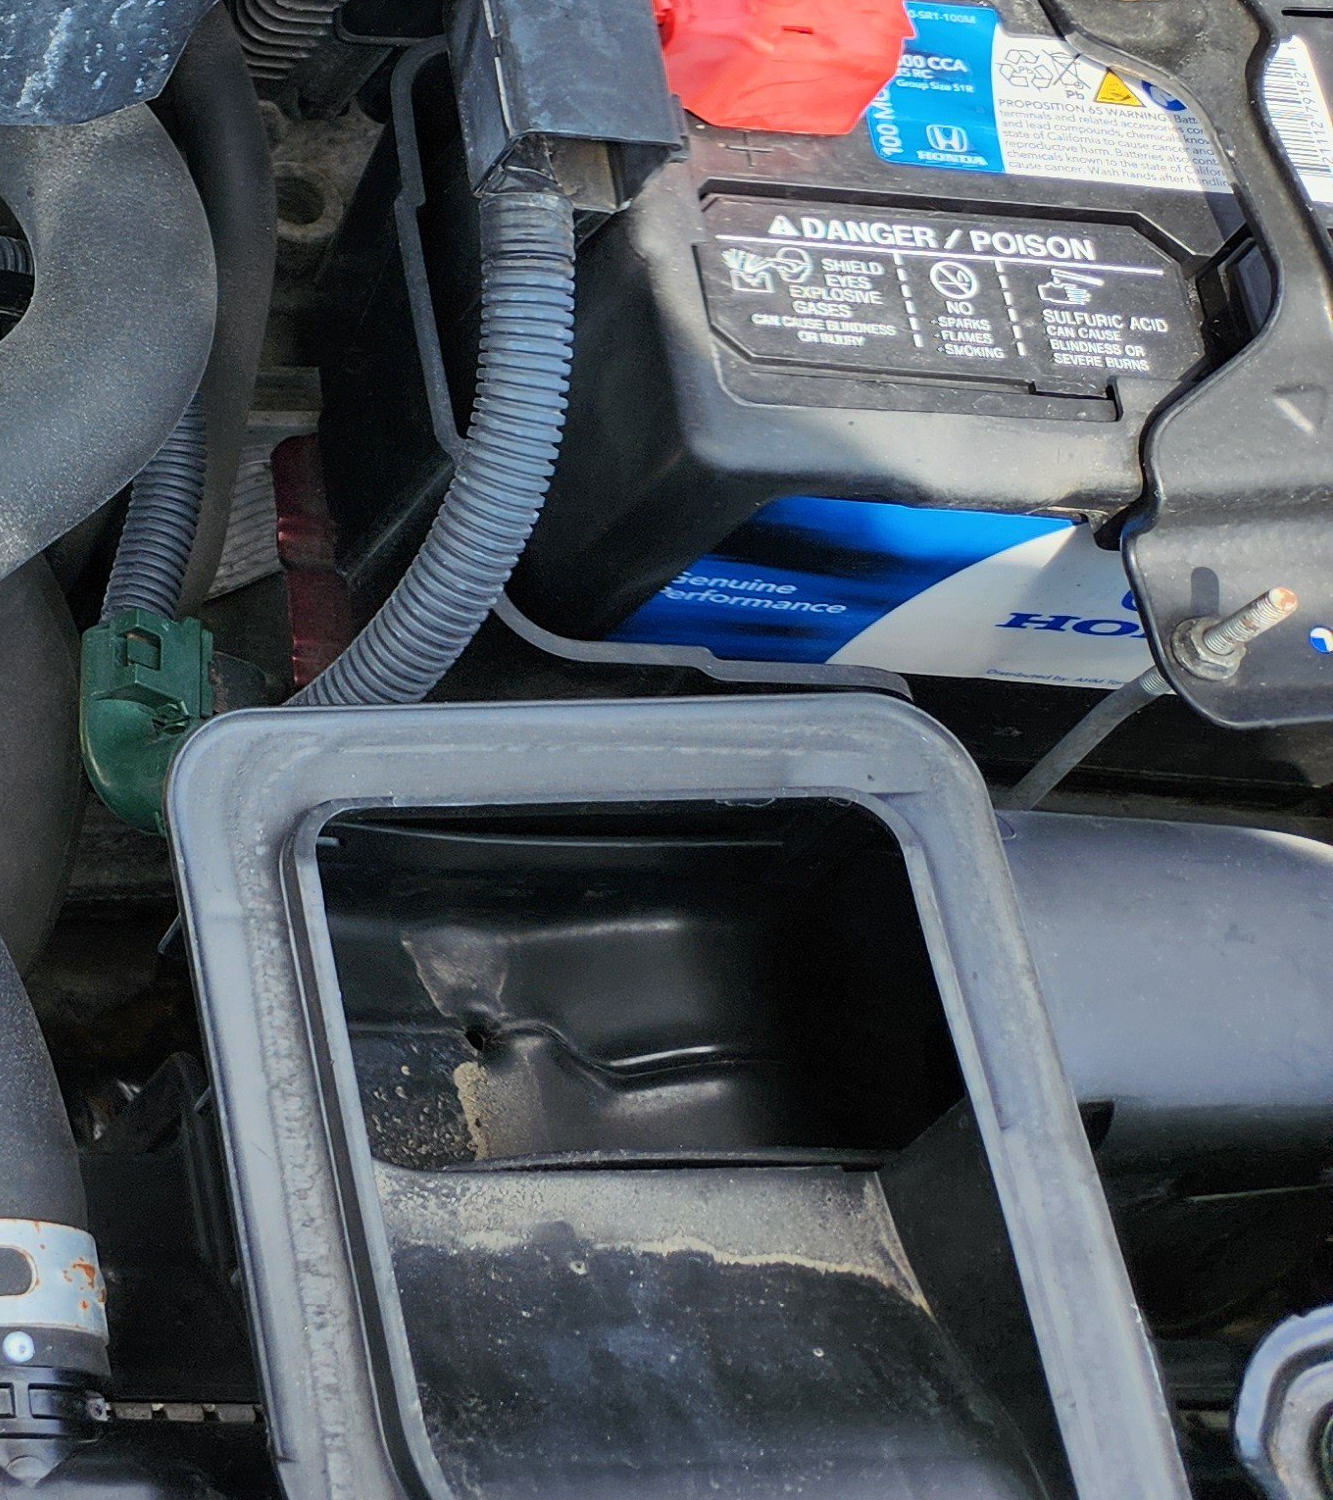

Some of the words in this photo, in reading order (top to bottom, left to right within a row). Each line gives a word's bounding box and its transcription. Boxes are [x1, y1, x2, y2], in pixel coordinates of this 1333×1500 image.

[898, 54, 926, 69] 00
[926, 57, 969, 73] CCA
[913, 68, 934, 80] RC
[896, 79, 929, 91] Group
[929, 81, 952, 92] Size
[1065, 89, 1086, 101] Pb
[998, 98, 1085, 114] PROPOSITION
[1088, 106, 1103, 116] 65
[1000, 109, 1052, 121] terminals
[1054, 113, 1076, 123] and
[1078, 116, 1118, 127] related
[1002, 120, 1023, 129] and
[1026, 120, 1051, 131] lead
[876, 123, 905, 158] 100
[1002, 129, 1030, 139] state
[1033, 130, 1045, 140] of
[1047, 131, 1101, 145] California
[1103, 138, 1115, 147] to
[1117, 141, 1149, 151] cause
[916, 150, 989, 166] HONDA
[1005, 140, 1078, 153] reproductive
[1115, 148, 1164, 162] Batteries
[1006, 150, 1063, 162] chemicals
[1065, 152, 1103, 165] known
[1105, 158, 1117, 167] to
[1120, 160, 1138, 169] the
[1140, 162, 1168, 171] state
[1170, 163, 1181, 173] of
[1008, 160, 1042, 170] cause
[1087, 166, 1119, 177] Wash
[1121, 169, 1157, 181] hands
[1159, 174, 1186, 184] after
[800, 218, 938, 249] DANGER
[968, 230, 1097, 261] POISON
[821, 258, 885, 275] SHIELD
[824, 273, 874, 290] EYES
[788, 285, 885, 304] EXPLOSIVE
[792, 301, 854, 319] GASES
[946, 301, 974, 316] NO
[750, 313, 781, 326] CAN
[782, 316, 826, 330] CAUSE
[826, 320, 898, 337] BLINDNESS
[938, 317, 991, 332] SPARKS
[1042, 309, 1125, 330] SULFURIC
[1129, 316, 1170, 334] ACID
[797, 330, 819, 343] OR
[820, 333, 867, 347] INJURY
[941, 331, 993, 345] FLAMES
[1046, 326, 1076, 340] CAN
[1077, 328, 1123, 342] CAUSE
[944, 345, 1006, 360] SMOKING
[1050, 339, 1122, 356] BLINDNESS
[1124, 345, 1147, 358] OR
[1052, 352, 1104, 368] SEVERE
[1105, 357, 1151, 372] BURNS
[671, 571, 798, 595] Genuine
[995, 612, 1147, 638] HO
